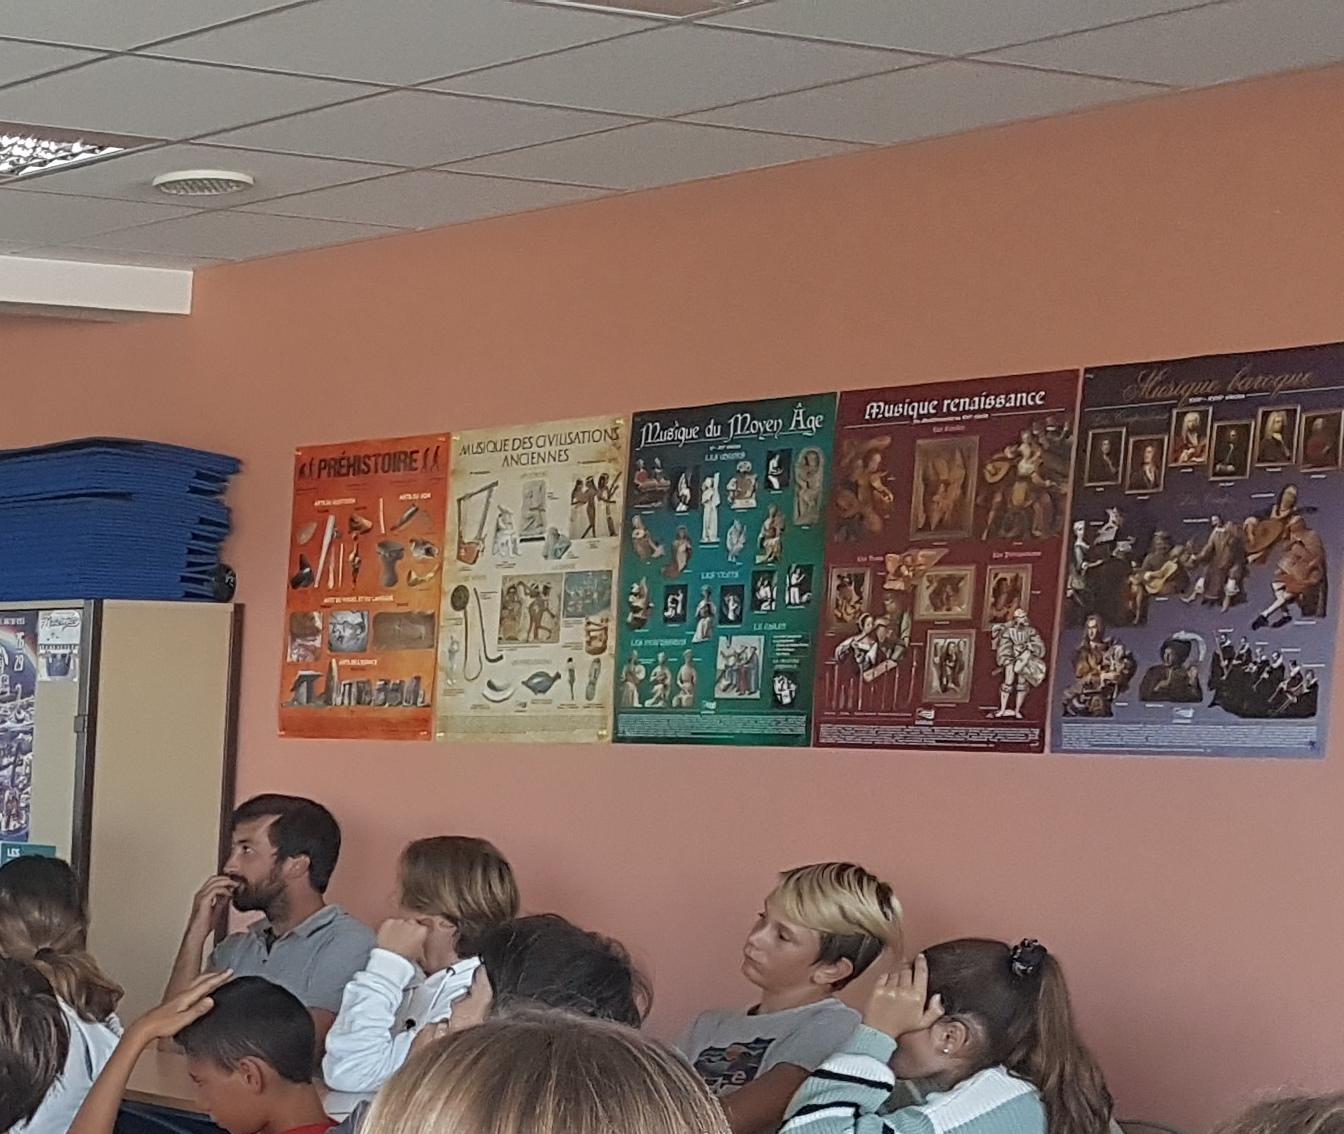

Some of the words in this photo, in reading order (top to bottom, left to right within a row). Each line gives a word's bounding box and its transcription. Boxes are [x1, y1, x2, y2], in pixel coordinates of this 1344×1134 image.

[865, 398, 937, 419] Musique
[943, 391, 1045, 413] renaissance
[636, 420, 699, 450] Musique
[705, 419, 721, 438] du
[724, 413, 783, 442] Moyen
[789, 402, 824, 435] Âge
[460, 438, 510, 456] MUSIQUE
[512, 436, 533, 450] DES
[535, 426, 620, 449] CIVILISATIONS
[317, 450, 420, 479] PRÉHISTOIRE
[502, 449, 569, 467] ANCIENNES
